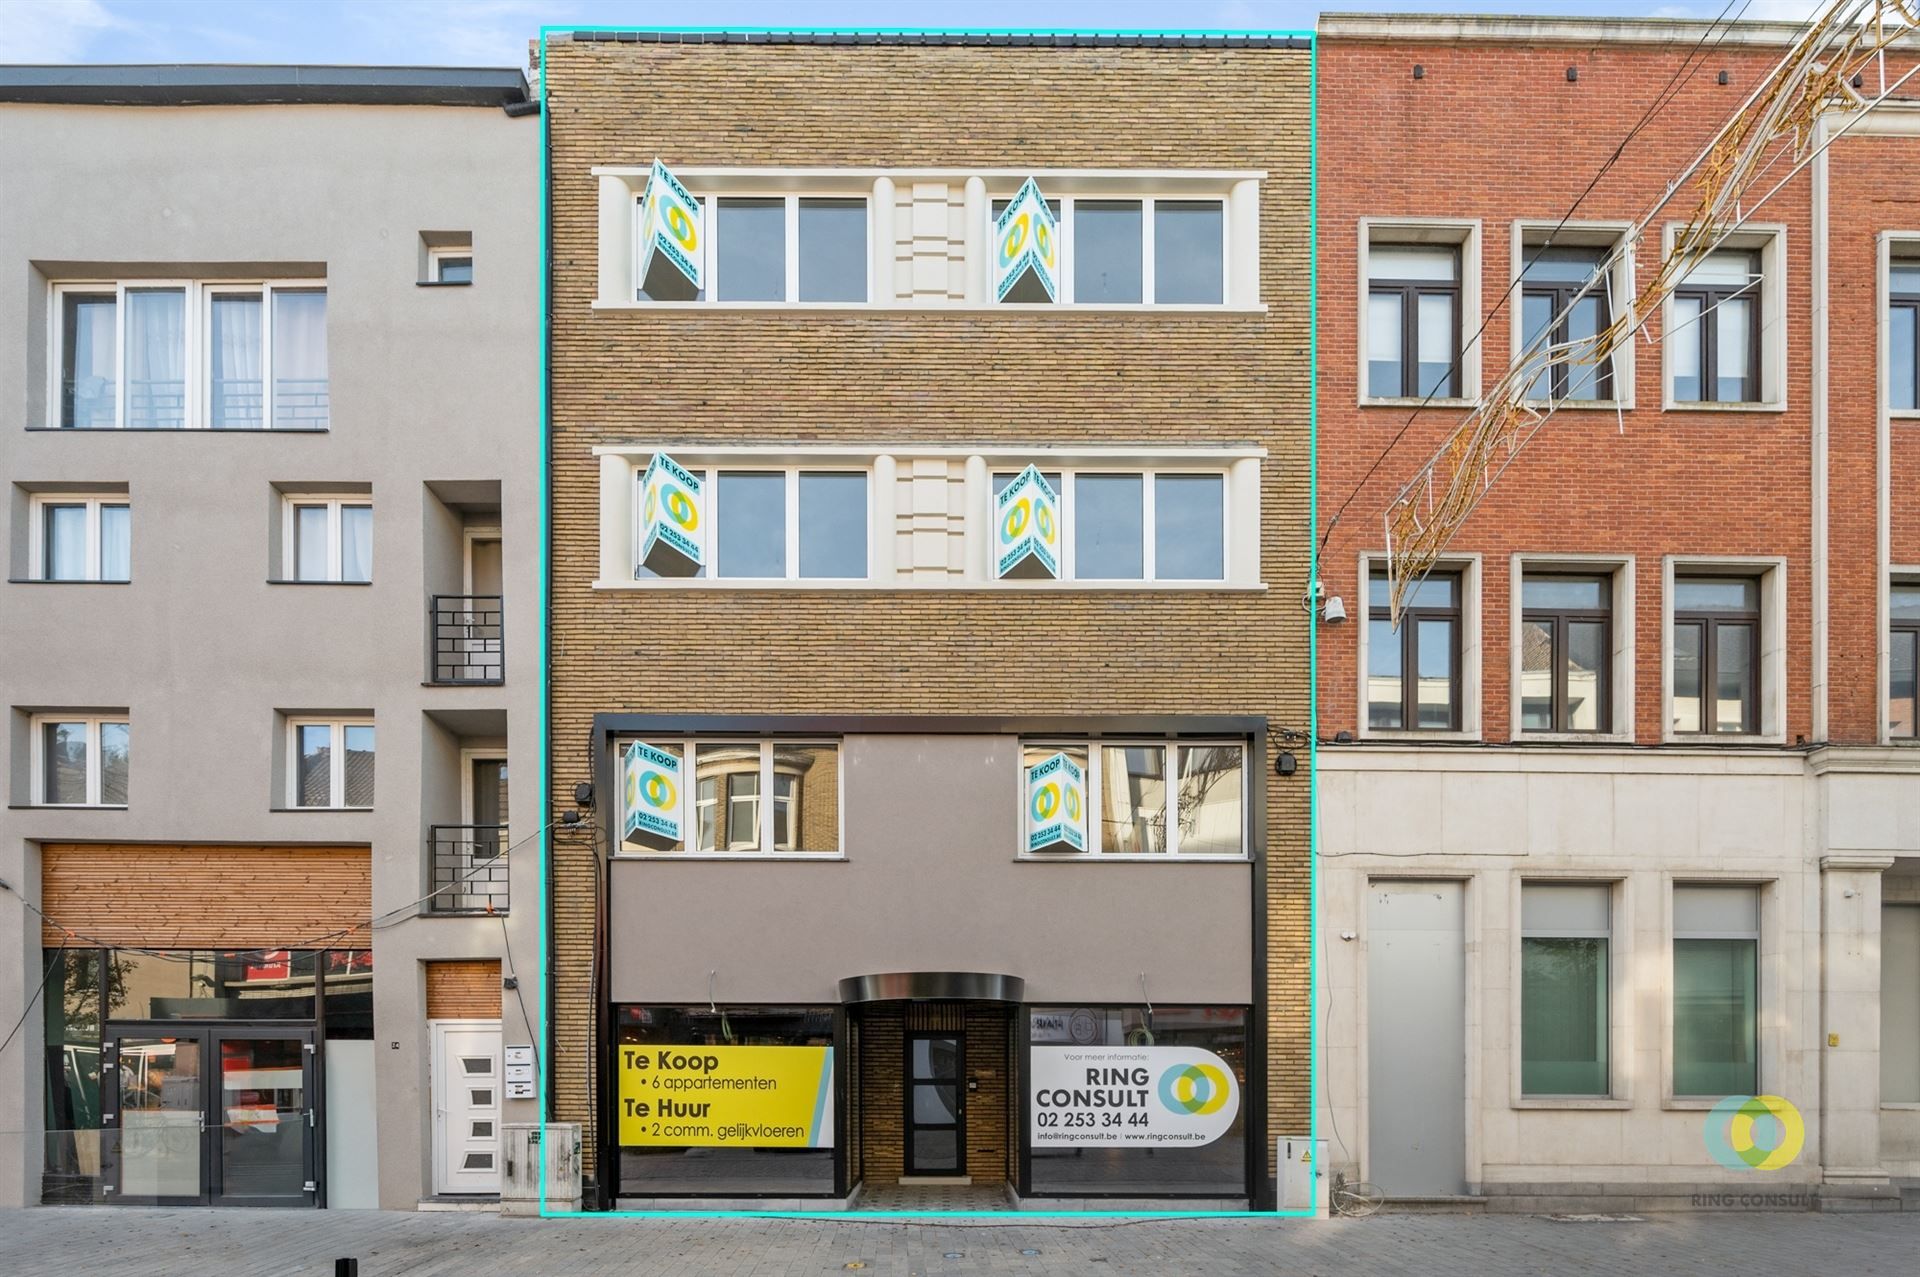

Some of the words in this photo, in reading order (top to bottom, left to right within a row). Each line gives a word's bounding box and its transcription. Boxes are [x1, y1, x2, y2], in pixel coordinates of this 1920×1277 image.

[658, 164, 669, 182] TE
[671, 181, 699, 212] KOOP
[998, 218, 1006, 230] TE
[1007, 185, 1030, 217] KOOP
[660, 456, 670, 471] TE
[672, 469, 699, 490] KOOP
[1000, 493, 1008, 505] TE
[1009, 471, 1031, 497] KOOP
[638, 746, 648, 758] TE
[650, 751, 677, 769] KOOP
[1031, 769, 1038, 780] TE
[1040, 759, 1060, 776] KOOP
[638, 812, 647, 820] 02
[648, 815, 660, 825] 253
[624, 1051, 650, 1070] Te
[658, 1051, 719, 1074] Koop
[652, 1076, 660, 1089] 6
[664, 1076, 777, 1092] appartementen
[1086, 1068, 1149, 1086] RING
[1036, 1089, 1149, 1108] CONSULT
[624, 1099, 650, 1118] Te
[658, 1099, 711, 1118] Huur
[1037, 1112, 1058, 1127] 02
[1064, 1112, 1095, 1127] 253
[1102, 1112, 1122, 1127] 34
[1128, 1112, 1149, 1127] 44
[652, 1123, 660, 1136] 2
[664, 1125, 713, 1137] comm.
[718, 1123, 804, 1140] gelijkvloeren
[1037, 1132, 1118, 1141] info@ringconsult.be
[1125, 1132, 1206, 1141] www.ringconsult.be
